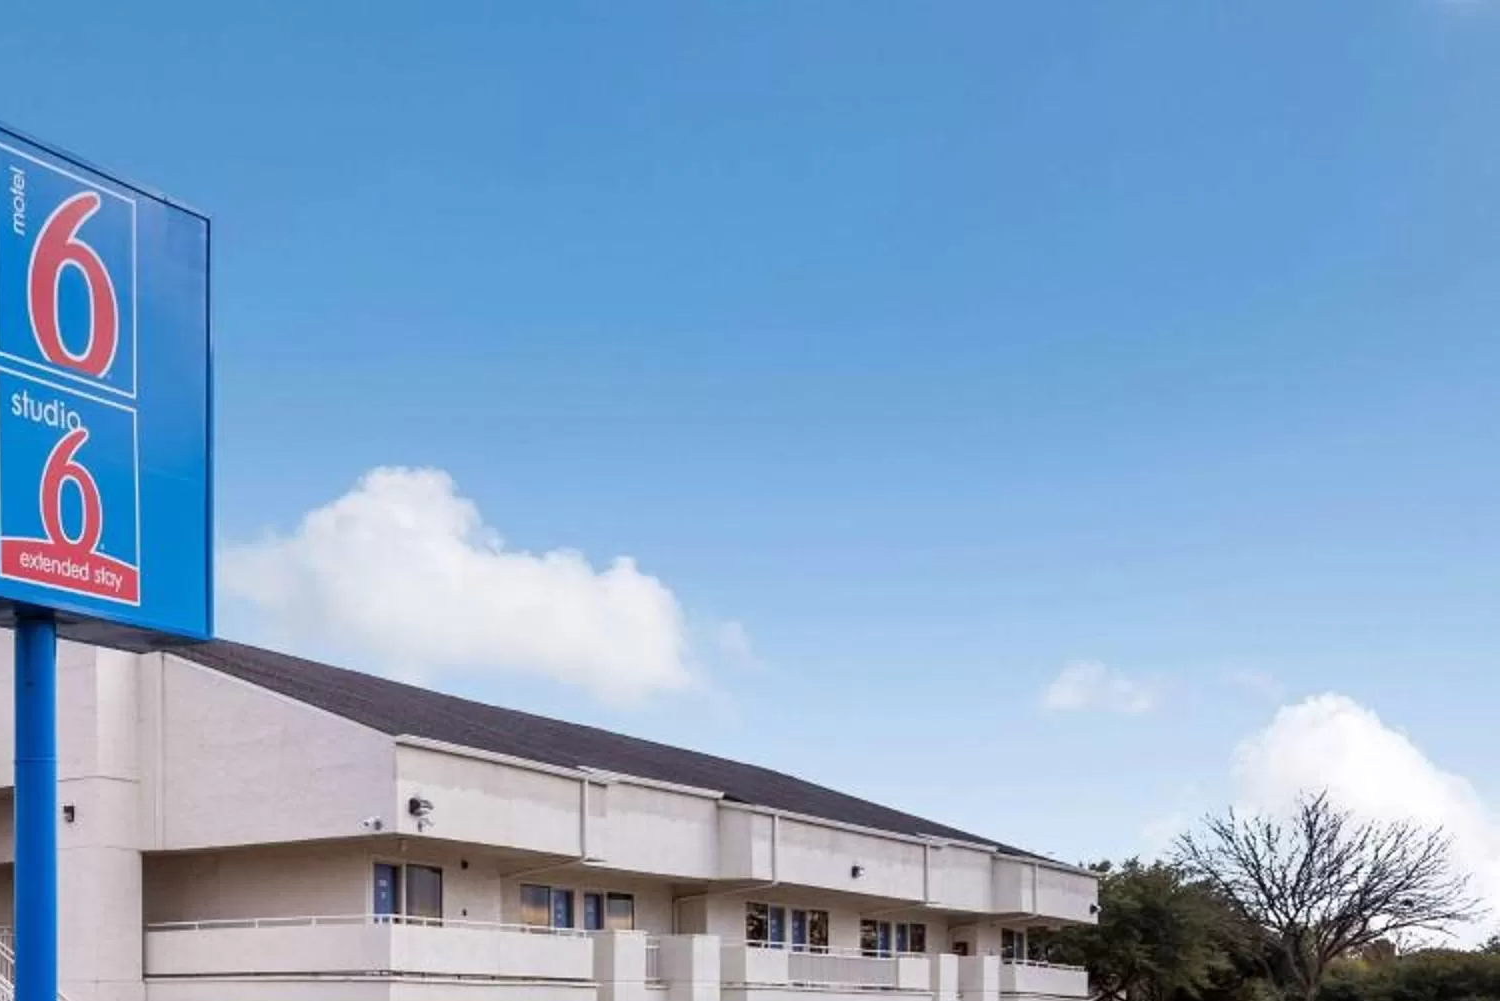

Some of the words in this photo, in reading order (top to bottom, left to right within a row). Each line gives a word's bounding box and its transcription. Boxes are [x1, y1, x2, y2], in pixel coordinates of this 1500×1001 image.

[10, 166, 26, 237] motel
[27, 191, 119, 378] 6
[11, 389, 82, 431] studio
[39, 427, 103, 553] 6
[19, 551, 90, 582] extended
[94, 569, 124, 592] stay
